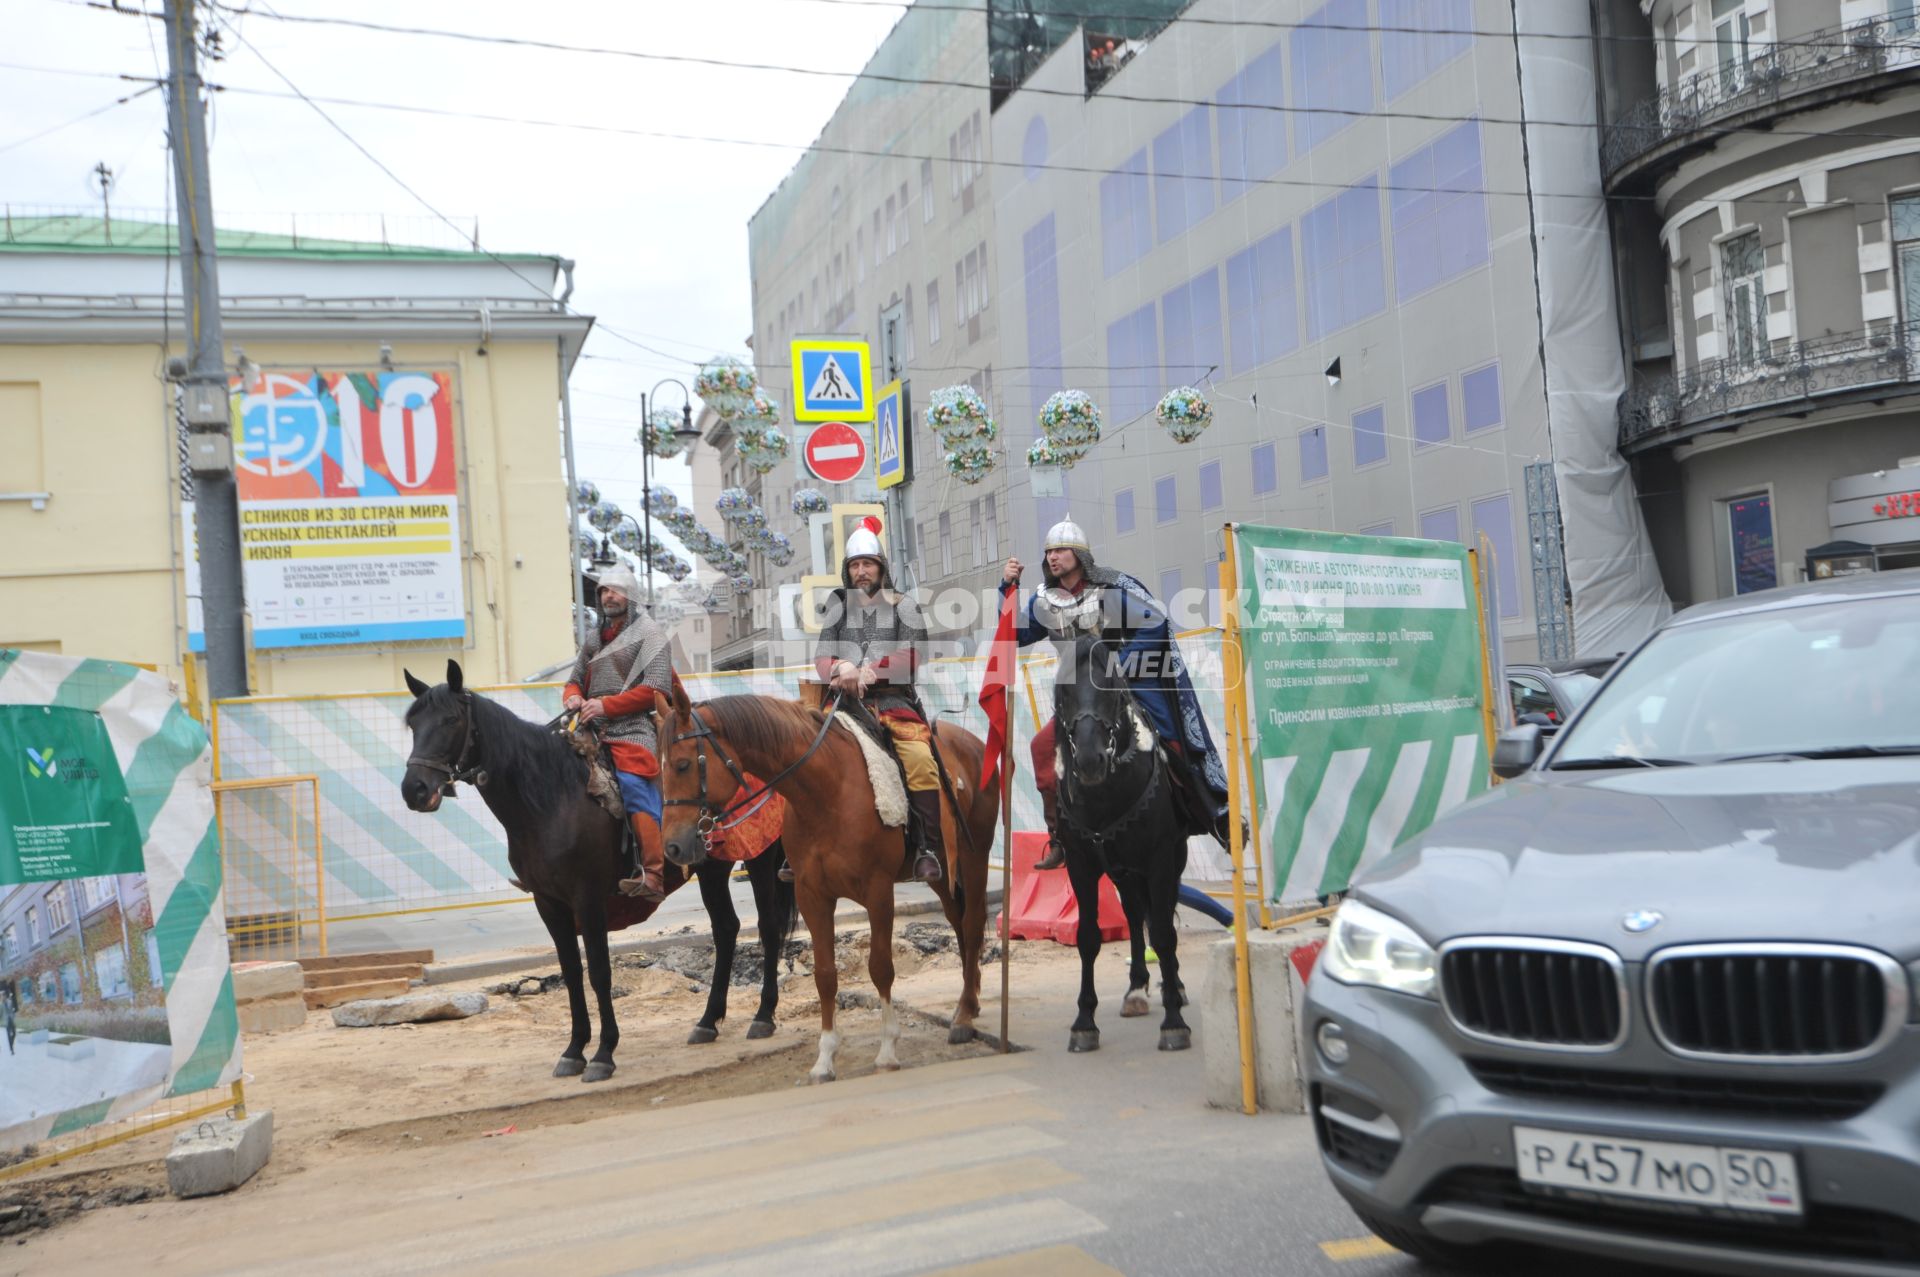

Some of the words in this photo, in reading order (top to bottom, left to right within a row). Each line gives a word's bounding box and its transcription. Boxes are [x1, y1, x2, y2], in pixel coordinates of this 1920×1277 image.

[315, 508, 334, 522] ИЗ
[339, 507, 356, 521] 30
[362, 505, 405, 520] СТРАН
[409, 503, 449, 519] МИРА
[307, 520, 397, 540] СПЕКТАКЛЕЙ
[250, 545, 293, 560] ИЮНЯ
[1264, 558, 1322, 575] ДВИЖЕНИЕ
[1324, 562, 1407, 579] АВТОТРАНСПОРТА
[1407, 567, 1460, 581] ОГРАНИЧЕНО
[1303, 581, 1310, 594] 8
[1345, 582, 1359, 596] ДО
[1262, 632, 1273, 643] от
[1275, 631, 1290, 646] ул.
[1290, 630, 1333, 643] Большая
[1376, 630, 1388, 643] до
[1401, 628, 1434, 644] Петровка
[1269, 707, 1326, 727] Приносим
[1328, 703, 1380, 721] извинения
[1381, 702, 1392, 716] за
[1728, 1154, 1776, 1190] 50
